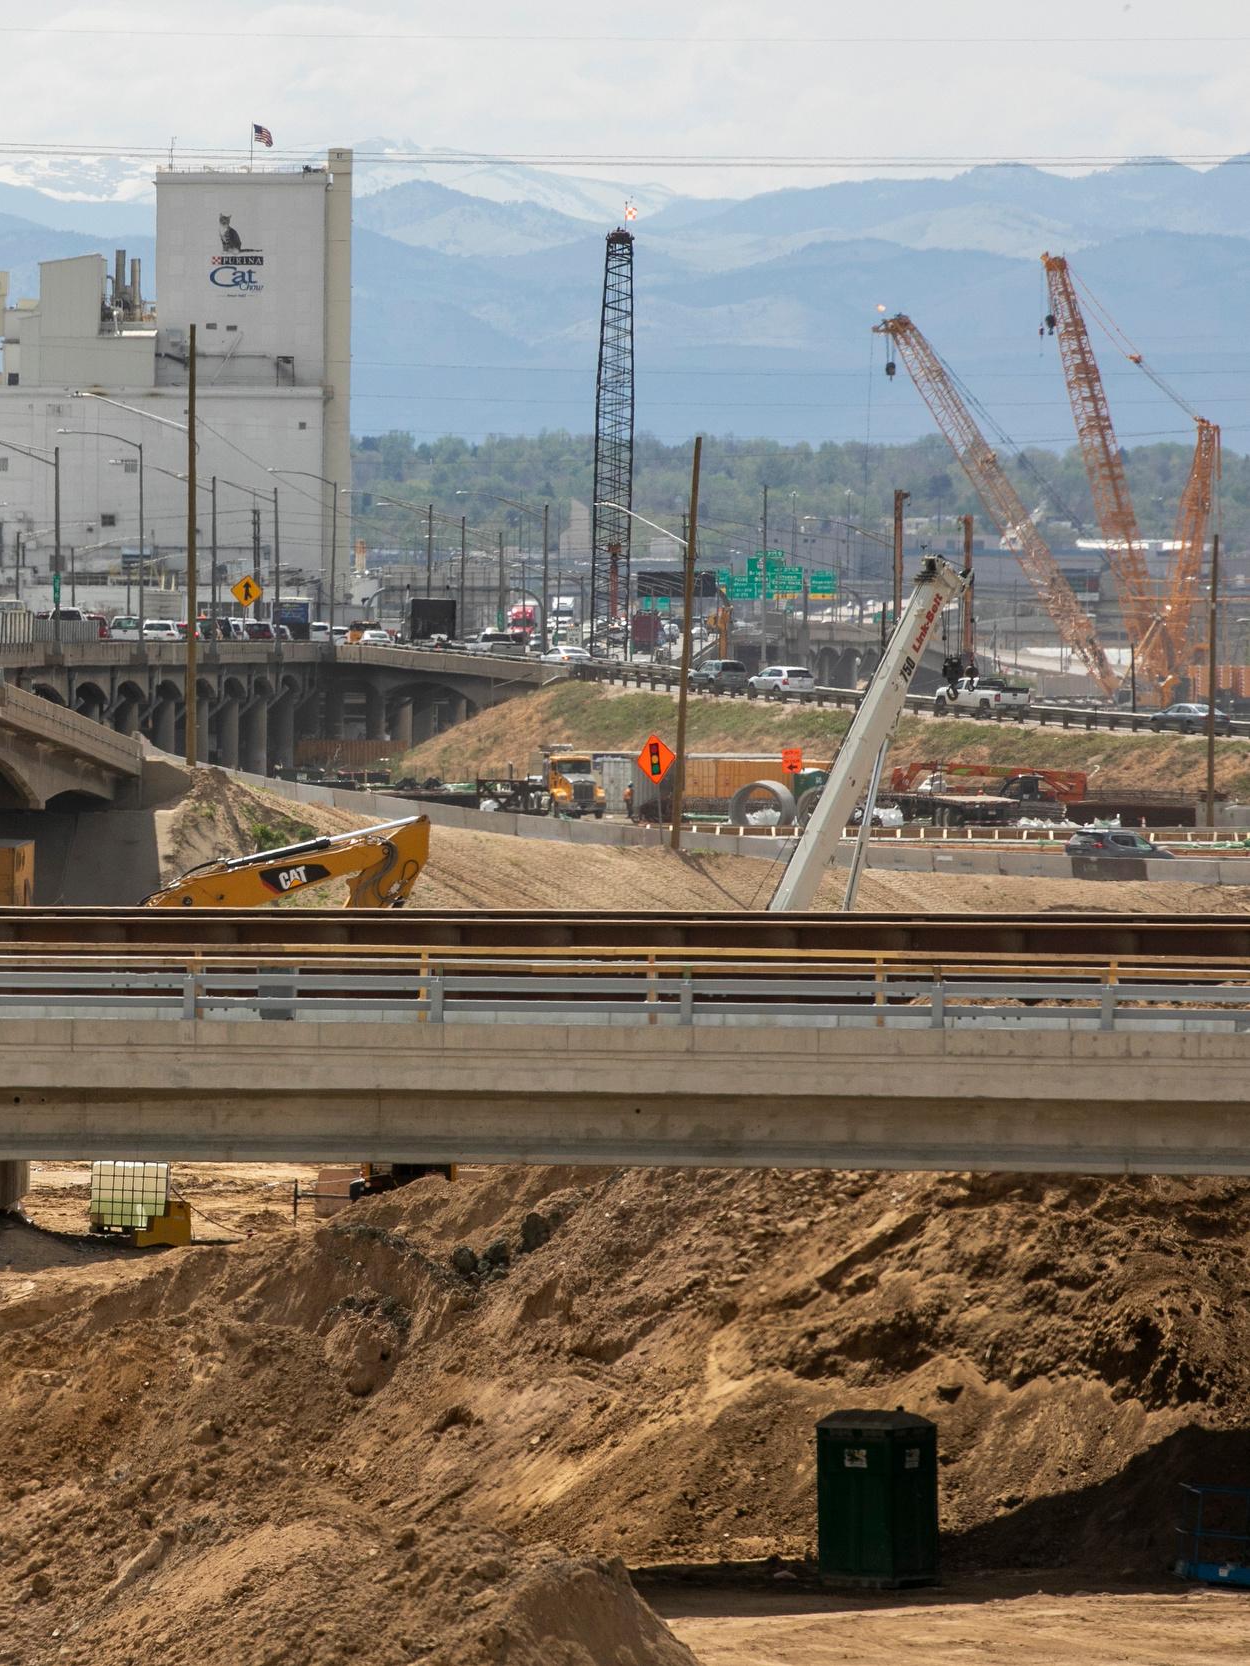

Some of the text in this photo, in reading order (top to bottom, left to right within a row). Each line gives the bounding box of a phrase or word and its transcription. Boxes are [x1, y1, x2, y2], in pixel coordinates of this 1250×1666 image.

[222, 255, 263, 266] PURINA
[209, 265, 258, 288] Cat
[911, 592, 944, 654] Link-Belt
[278, 865, 308, 890] CAT
